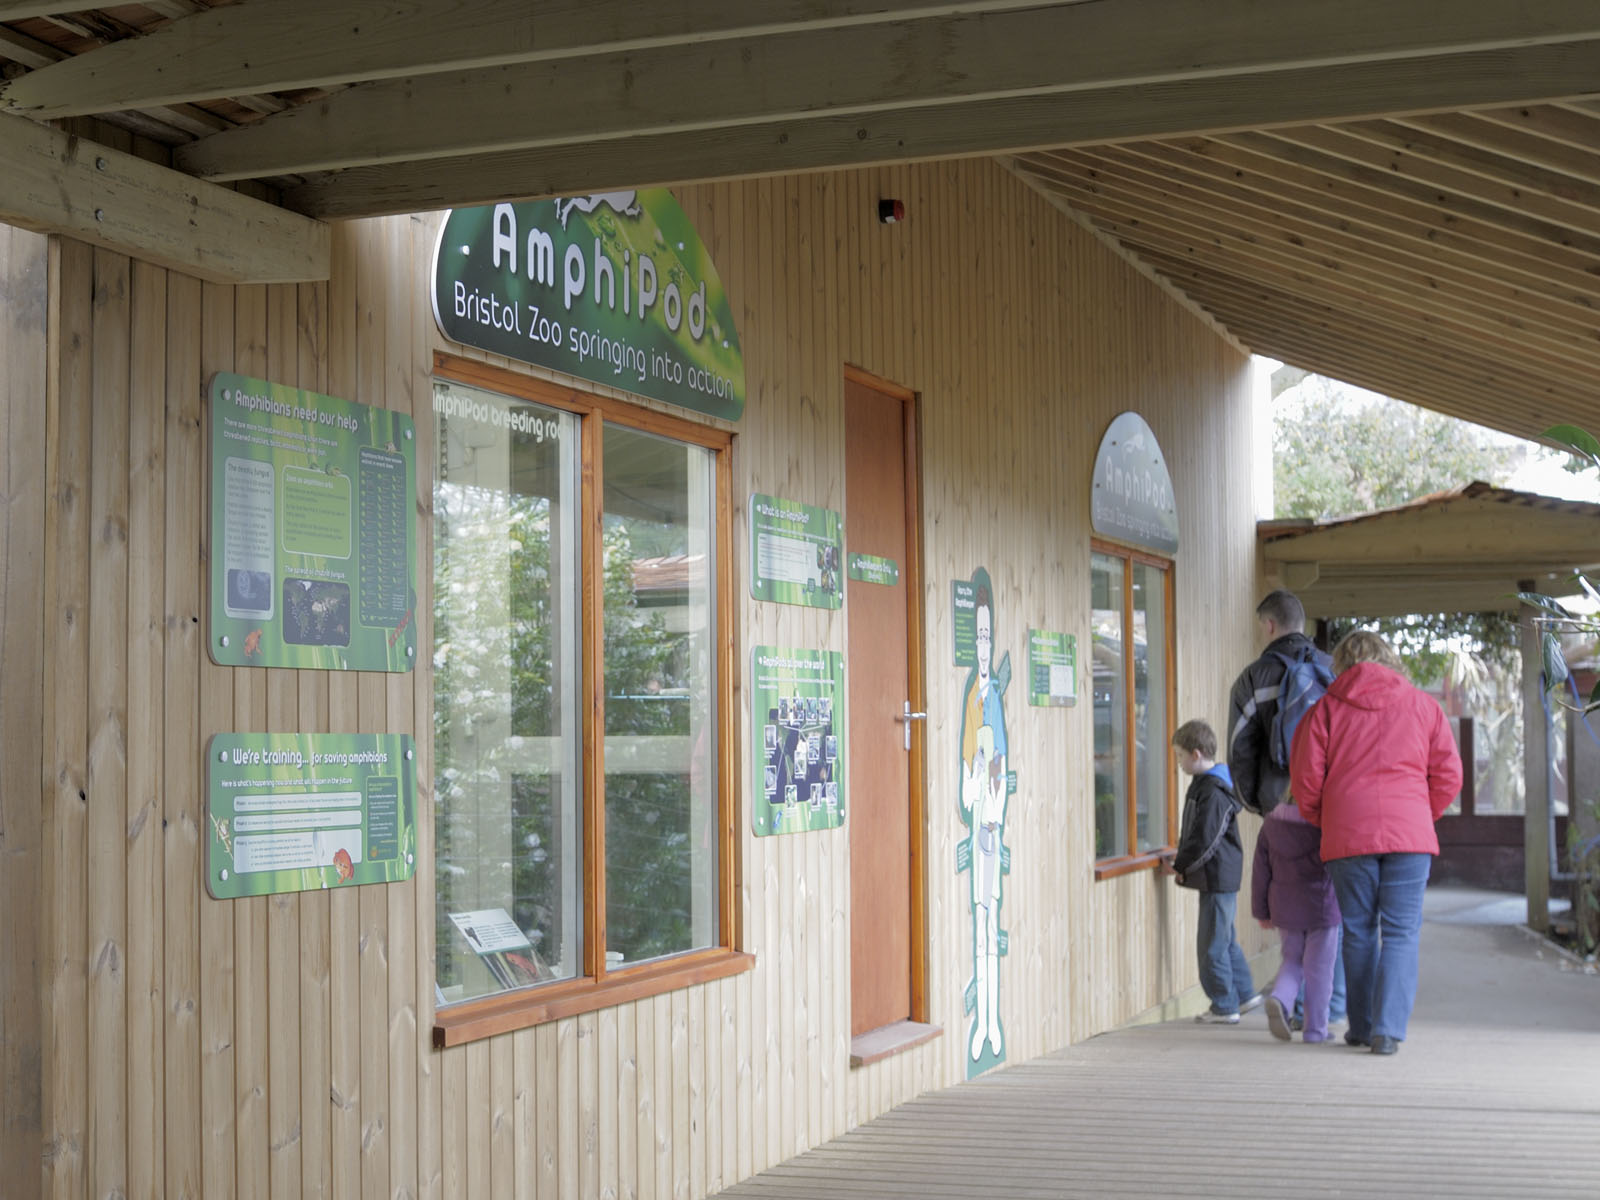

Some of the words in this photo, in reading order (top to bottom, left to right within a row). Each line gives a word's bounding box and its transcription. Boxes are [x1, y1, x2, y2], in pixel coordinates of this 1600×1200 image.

[493, 203, 705, 339] AmphiPod
[454, 280, 521, 335] Bristol
[528, 305, 562, 346] Zoo
[569, 326, 646, 382] springing
[652, 347, 682, 384] into
[688, 365, 733, 400] action
[235, 389, 291, 416] Amphibians
[293, 406, 317, 421] need
[319, 411, 335, 425] our
[337, 413, 358, 432] help
[491, 404, 543, 443] breeding
[233, 748, 259, 764] We're
[311, 751, 323, 767] for
[324, 752, 348, 767] saving
[349, 750, 388, 766] amphibians
